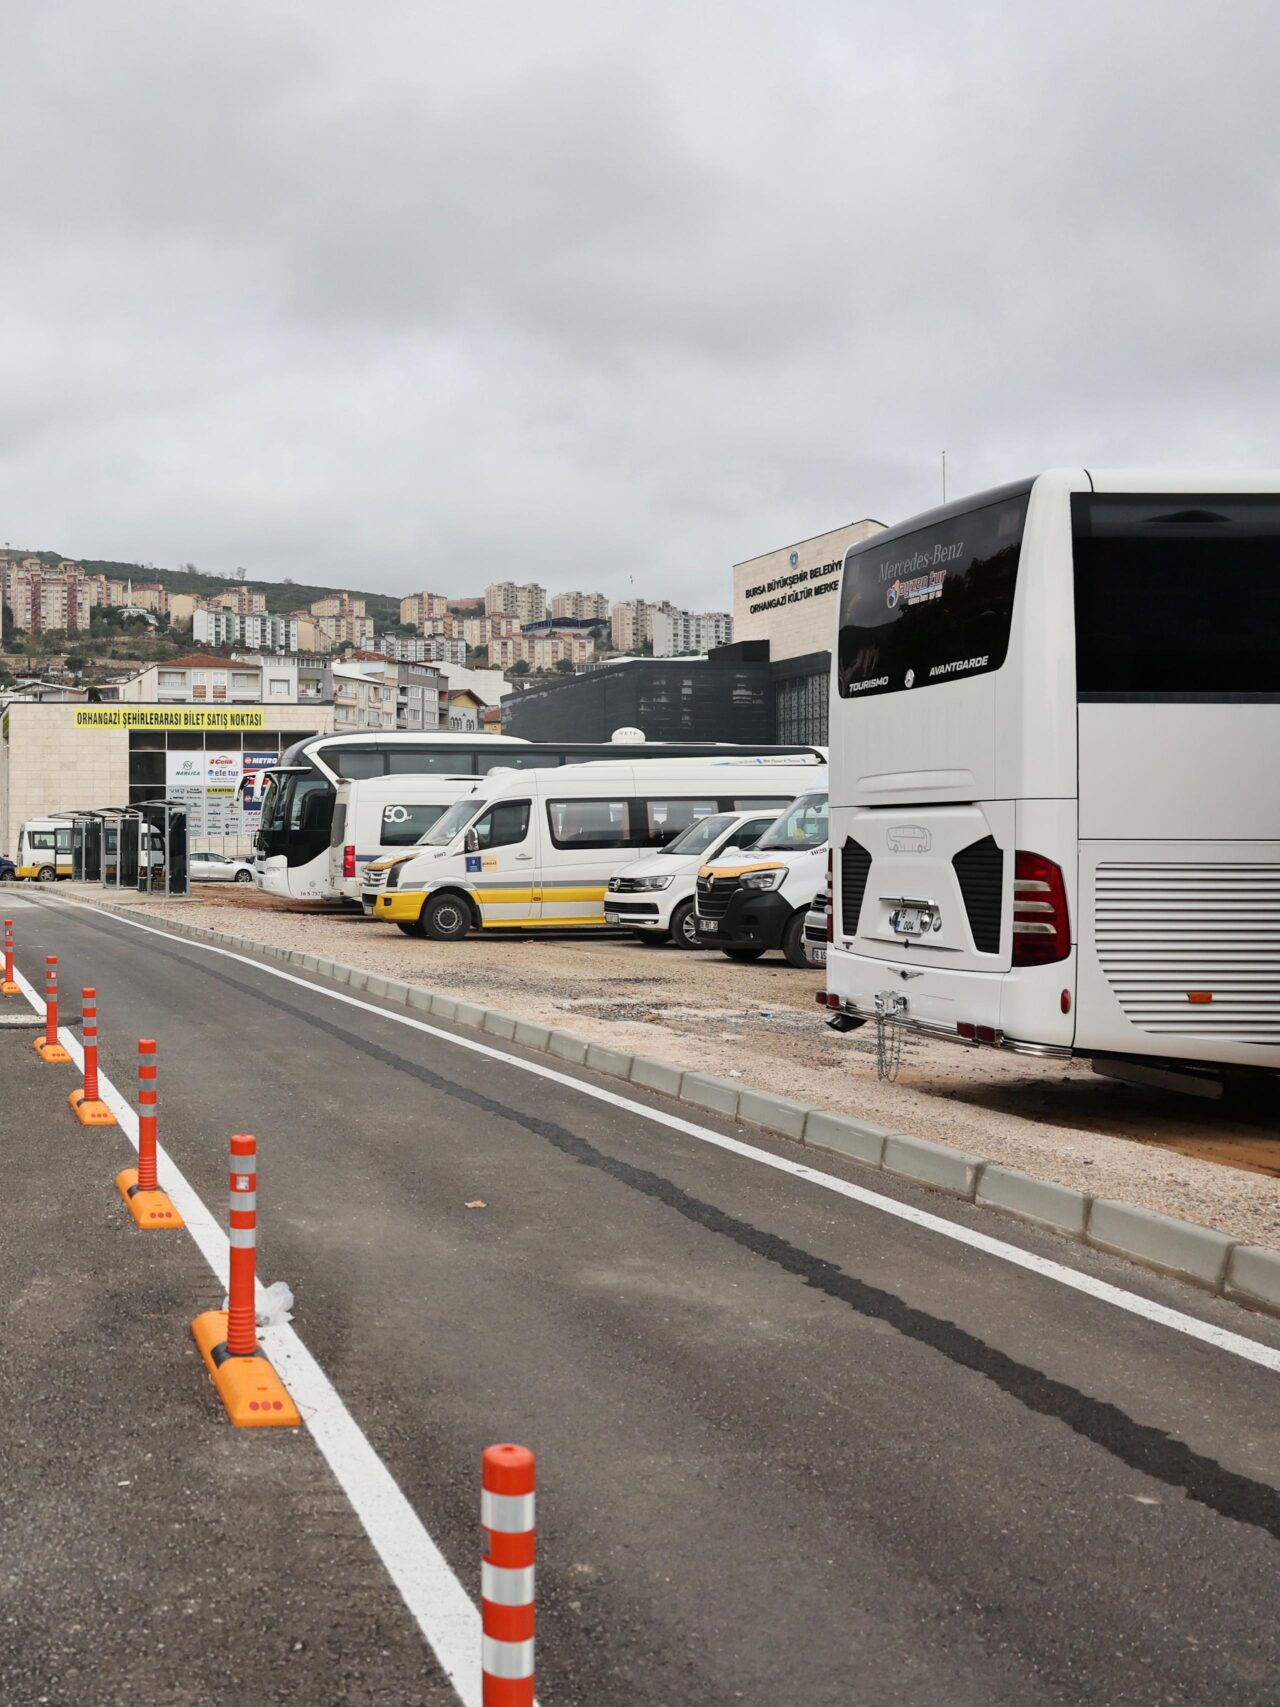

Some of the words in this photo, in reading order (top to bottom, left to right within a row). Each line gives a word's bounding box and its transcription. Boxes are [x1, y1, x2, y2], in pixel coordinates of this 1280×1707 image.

[878, 542, 964, 582] Mercedes-Benz
[745, 584, 766, 598] BURSA
[767, 570, 808, 592] BÜYÜKŞEHİR
[750, 593, 787, 614] ORHANGAZİ
[787, 586, 813, 603] KÜLTÜR
[929, 655, 989, 677] AVANTGARDE
[849, 676, 889, 693] TOURISMO
[77, 710, 120, 725] ORHANGAZİ
[123, 710, 181, 728] ŞEHİRLERARASI
[184, 711, 205, 726] BİLET
[207, 713, 228, 729] SATIŞ
[230, 714, 262, 726] NOKTASI
[252, 757, 278, 765] METRO
[214, 768, 228, 777] efe
[228, 769, 239, 777] tur
[384, 806, 408, 823] 50
